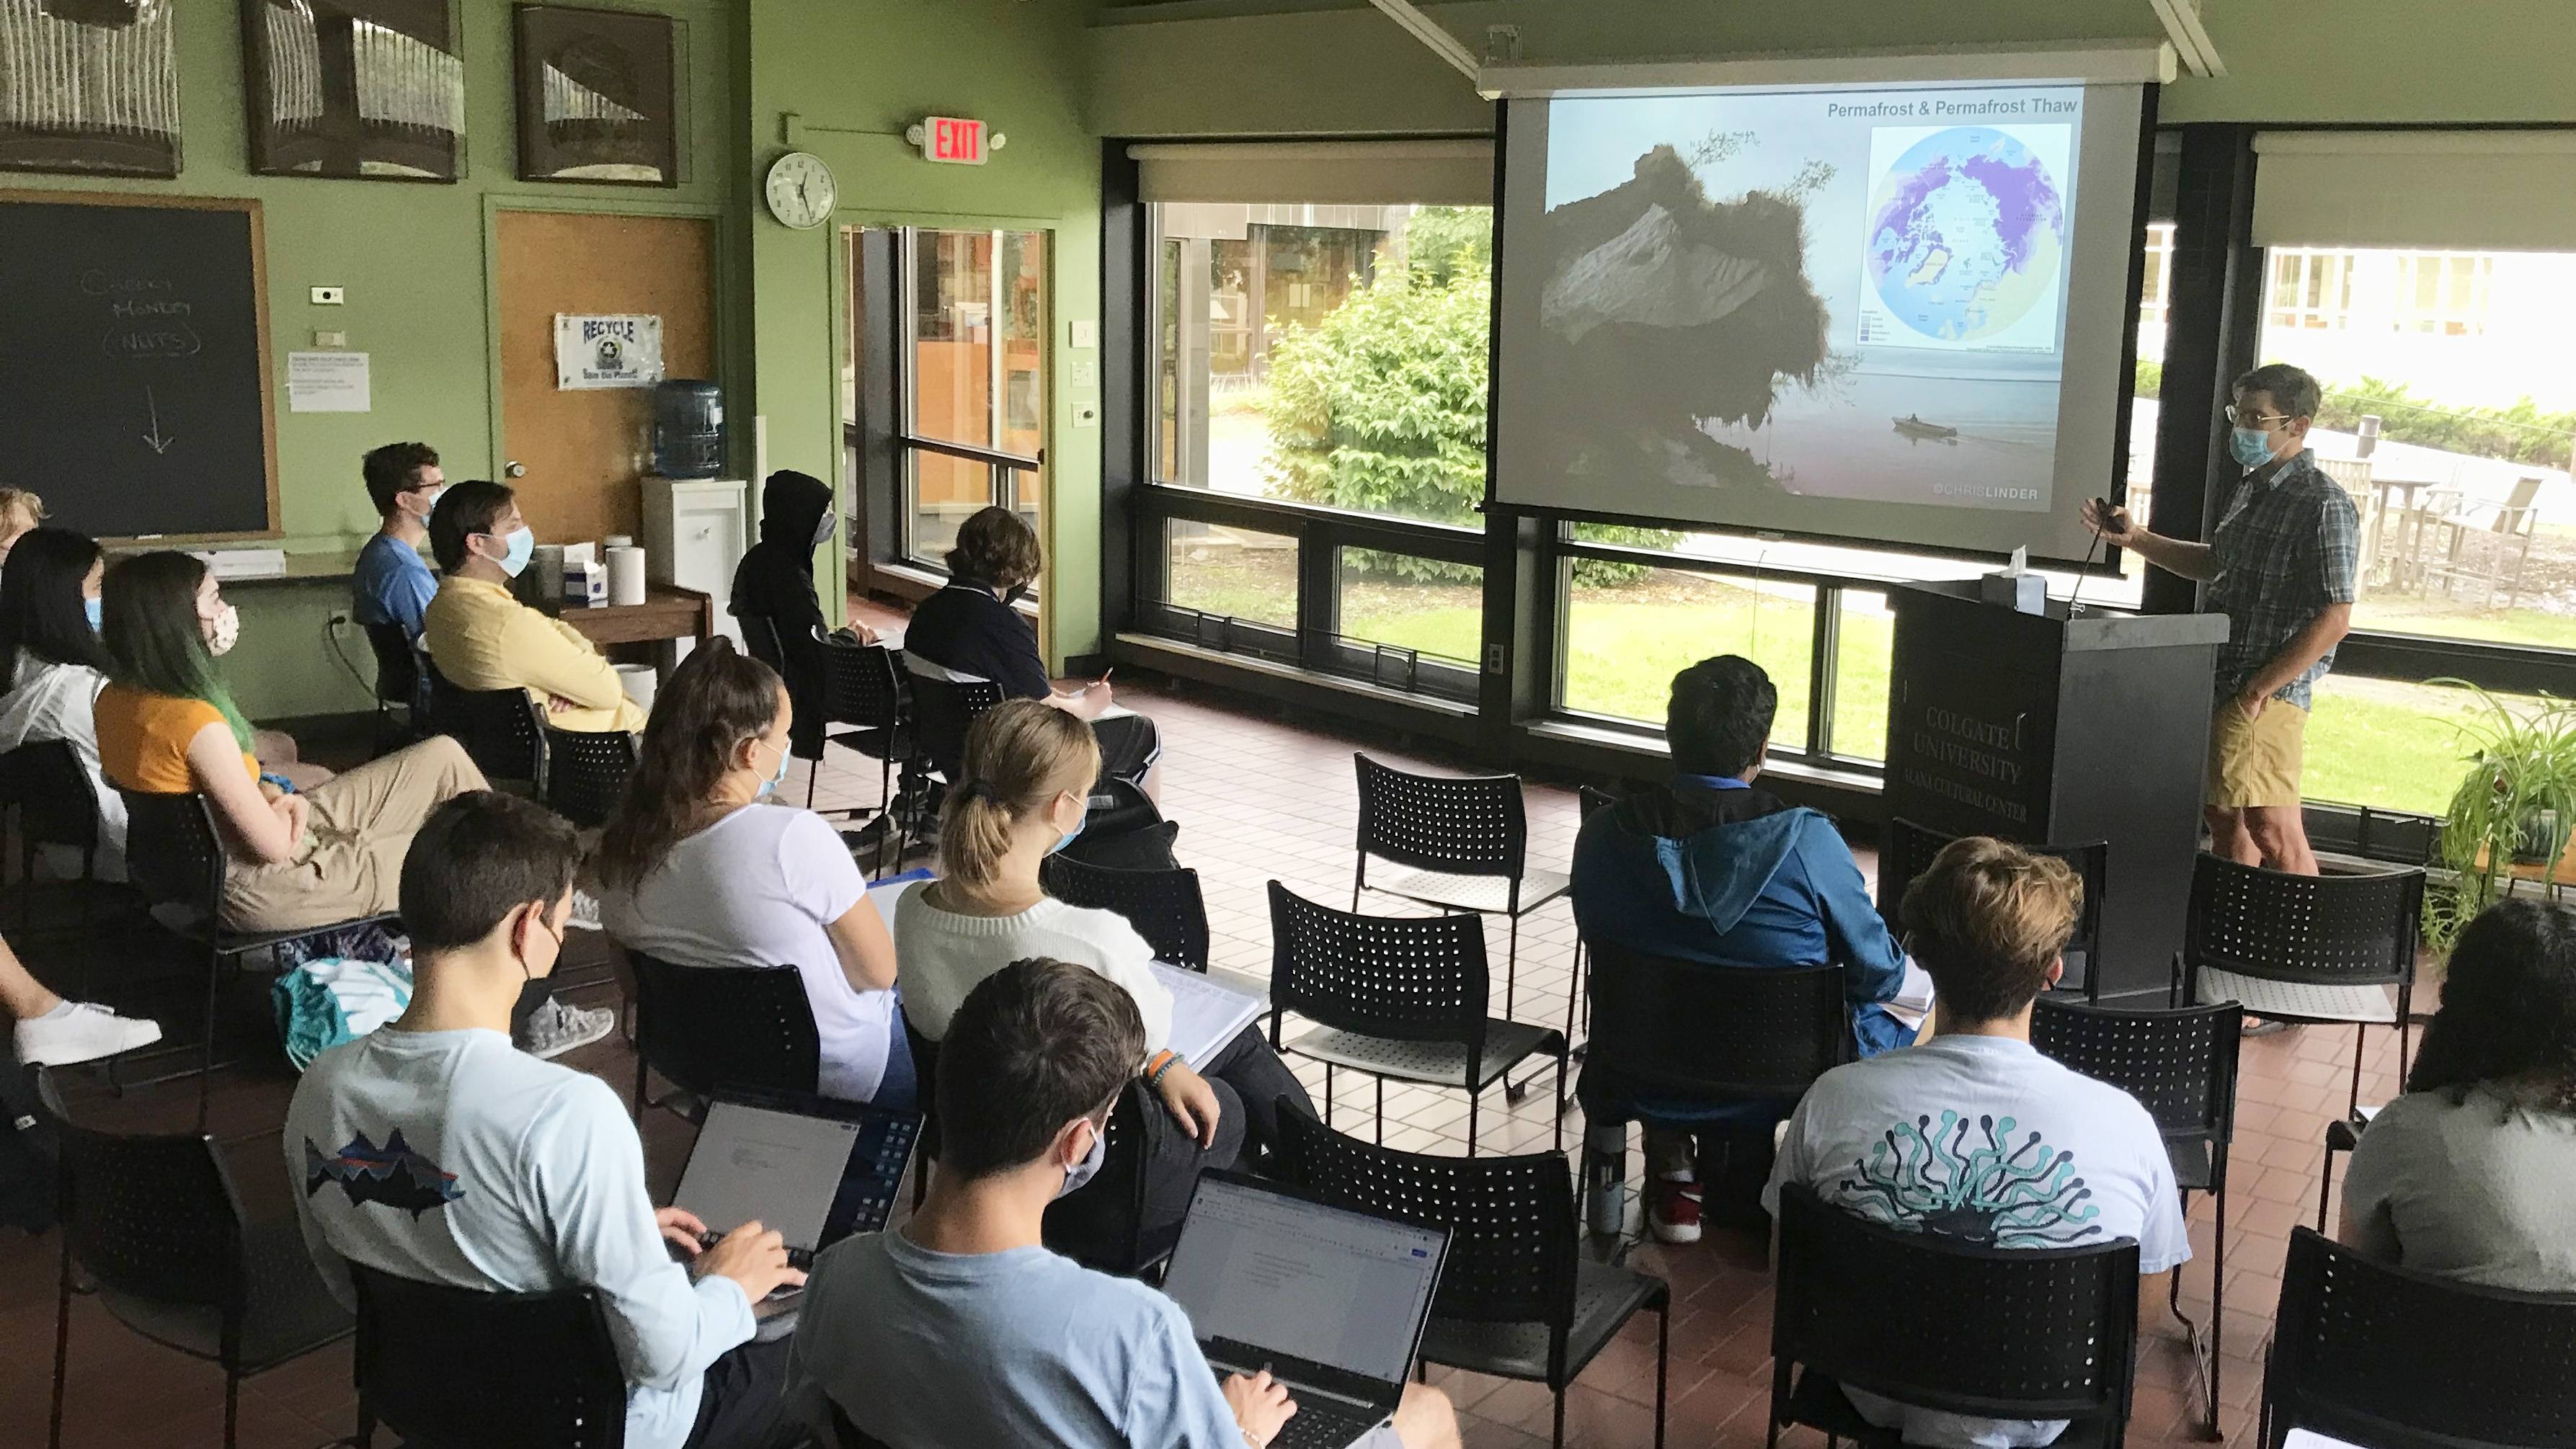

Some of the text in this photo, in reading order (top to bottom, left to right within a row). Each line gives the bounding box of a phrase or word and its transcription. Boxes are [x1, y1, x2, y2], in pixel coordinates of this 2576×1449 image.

[1828, 97, 2078, 117] Permafrost & Permafrost Thaw
[936, 119, 980, 162] EXIT
[820, 174, 825, 184] 2
[583, 320, 634, 345] RECYCLE
[1926, 706, 2009, 750] COLGATE
[1914, 732, 2022, 785] UNIVERSITY
[1934, 776, 1984, 808] CULTURAL
[1985, 793, 2028, 824] CENTER
